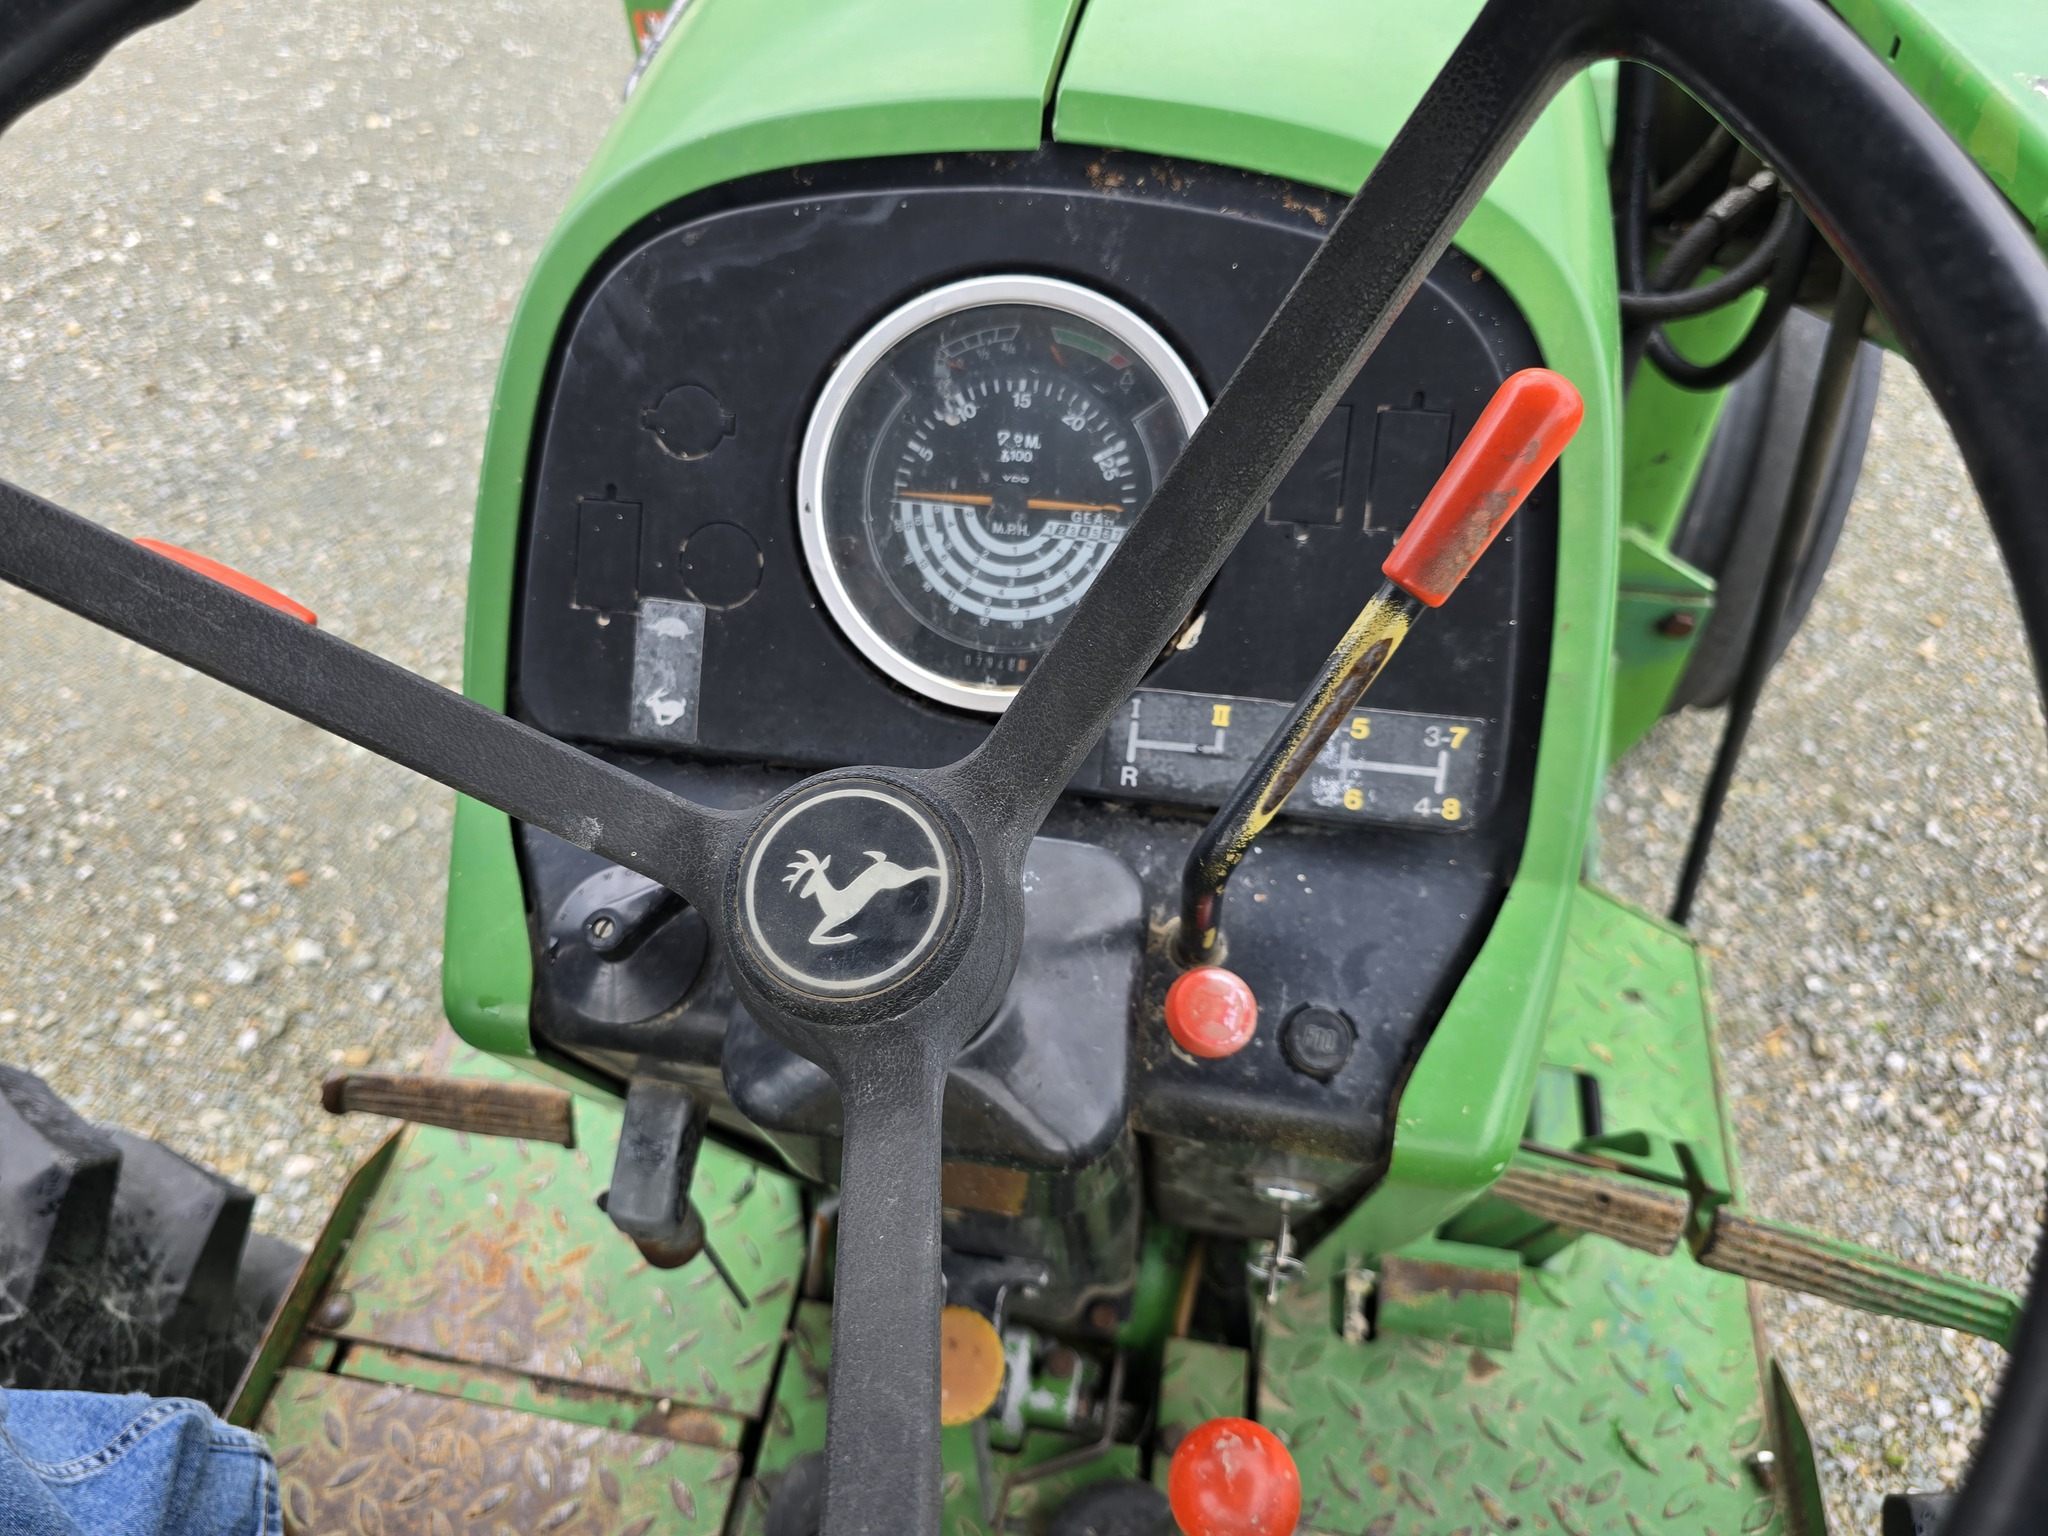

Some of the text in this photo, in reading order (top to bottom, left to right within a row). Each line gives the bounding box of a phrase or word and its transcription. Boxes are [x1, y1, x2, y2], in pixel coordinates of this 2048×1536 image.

[919, 392, 1120, 481] 5 10 15 20 25
[1001, 473, 1030, 484] VDO
[1131, 698, 1231, 727] I II
[1423, 725, 1470, 749] 3-7
[1120, 765, 1138, 787] R
[1412, 796, 1462, 821] 4-8
